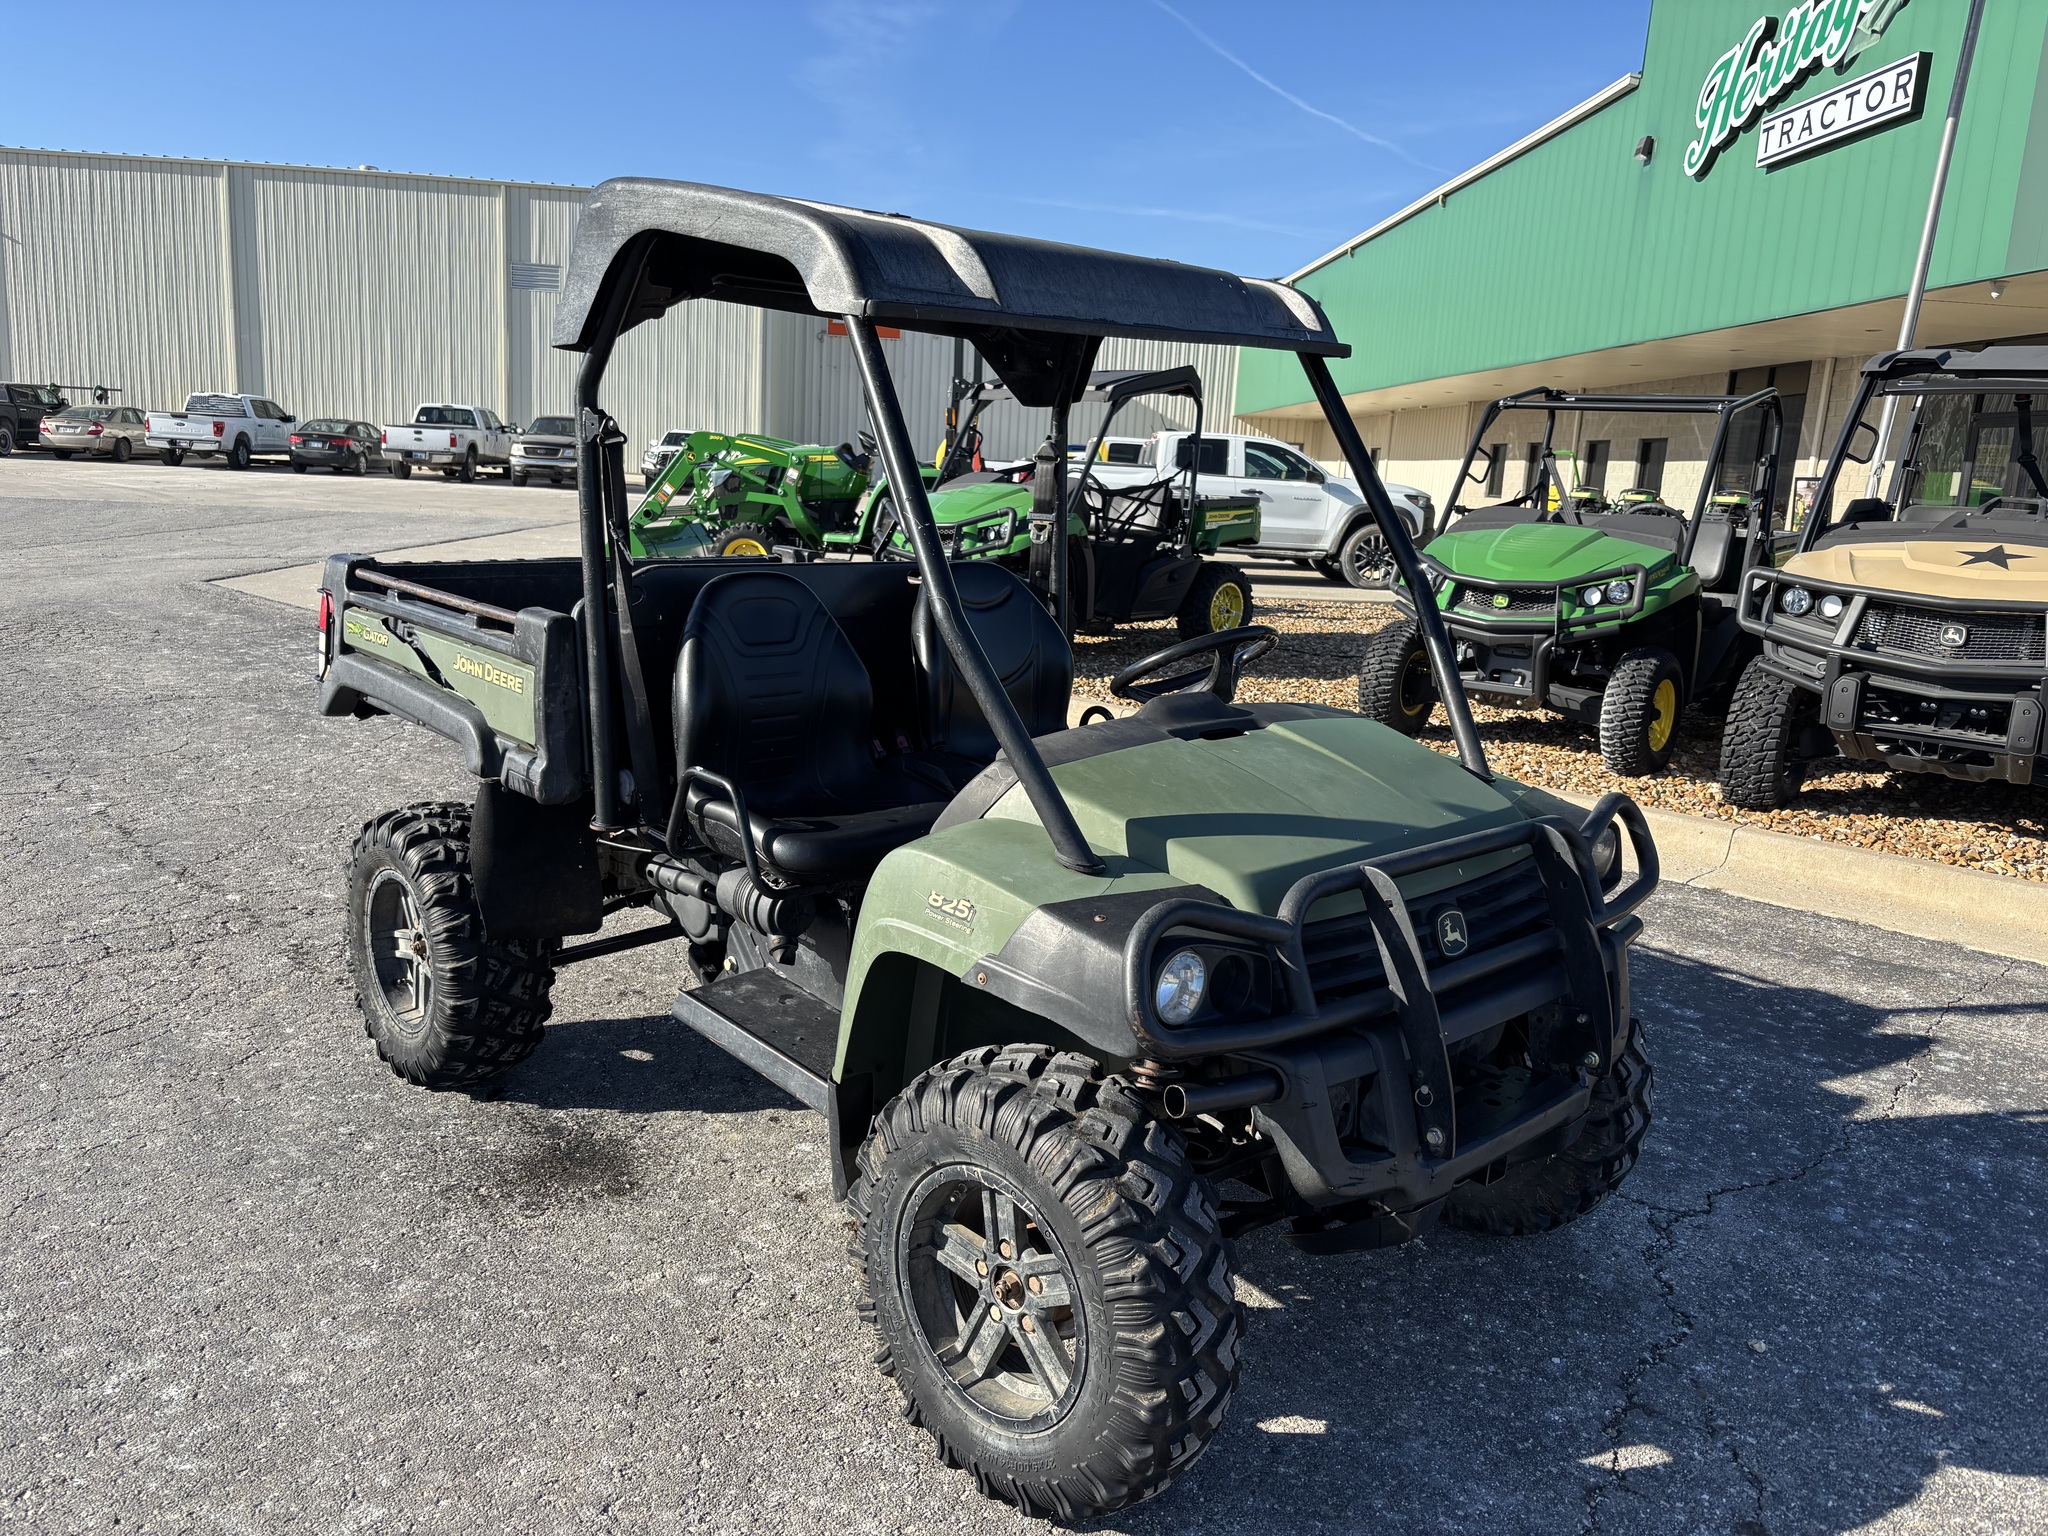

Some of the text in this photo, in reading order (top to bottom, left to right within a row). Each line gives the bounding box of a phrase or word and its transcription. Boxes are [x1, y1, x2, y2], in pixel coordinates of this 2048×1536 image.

[1762, 68, 1914, 154] TRACTOR
[363, 627, 388, 647] GATOR
[453, 652, 524, 695] JOHN DEERE
[924, 908, 972, 935] Power Steering
